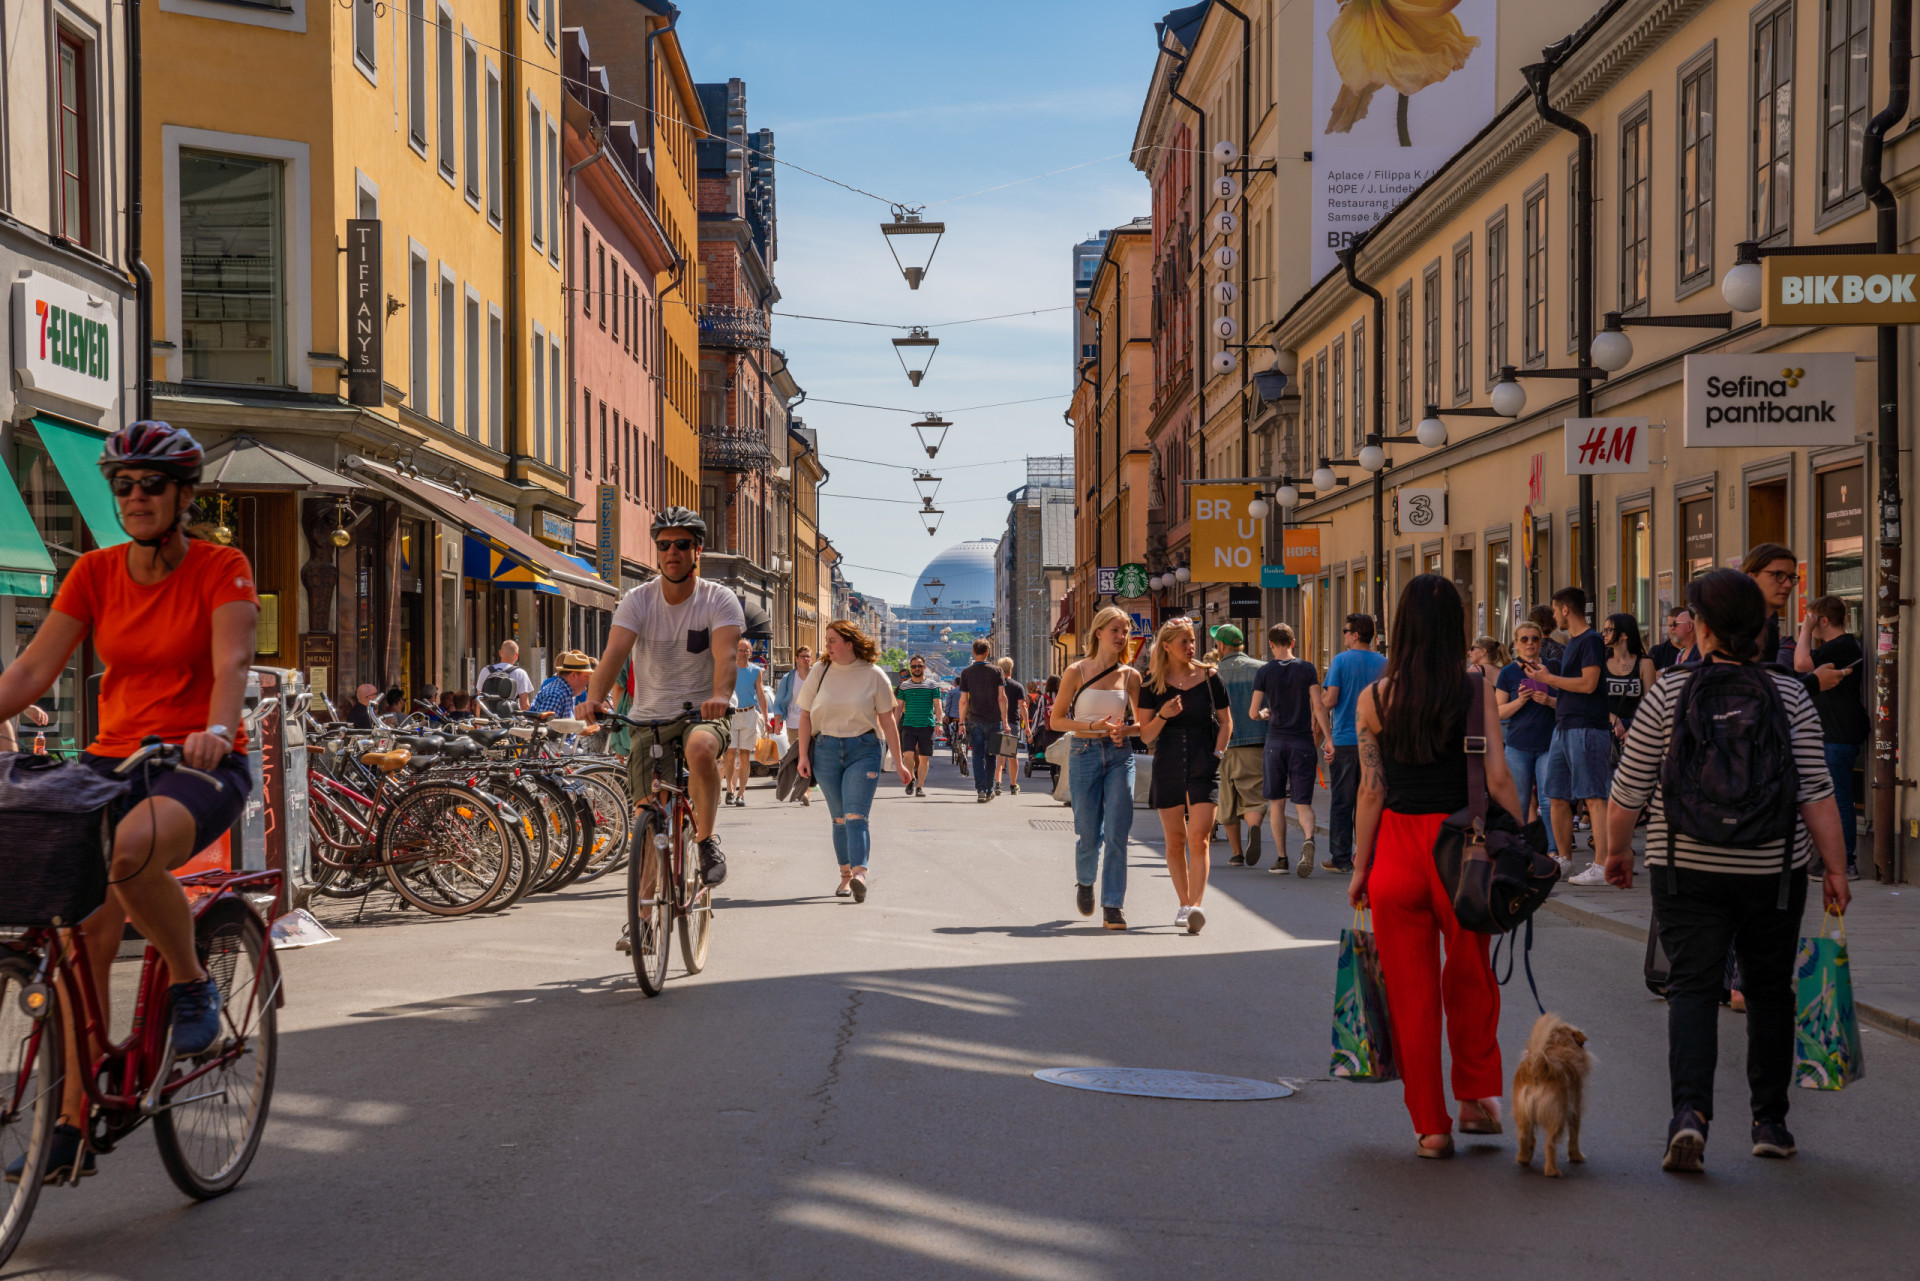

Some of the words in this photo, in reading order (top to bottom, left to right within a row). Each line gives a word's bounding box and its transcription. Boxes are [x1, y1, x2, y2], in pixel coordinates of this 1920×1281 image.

[1328, 170, 1364, 181] Aplace
[1374, 170, 1411, 181] Filippa
[1414, 170, 1422, 179] K
[1328, 185, 1357, 194] HOPE
[1367, 184, 1377, 193] J.
[1328, 198, 1389, 209] Restaurang
[1219, 181, 1233, 337] BRUNO
[356, 228, 372, 365] TIFFANY'S
[1781, 275, 1840, 305] BIK
[1842, 273, 1918, 304] BOK
[1706, 376, 1787, 398] Sefina
[1706, 400, 1836, 428] pantbank
[1578, 426, 1637, 466] H&M
[1196, 499, 1231, 520] BR
[1238, 518, 1255, 539] U
[1214, 546, 1252, 568] NO
[1286, 546, 1319, 557] HOPE
[306, 655, 331, 663] MENU
